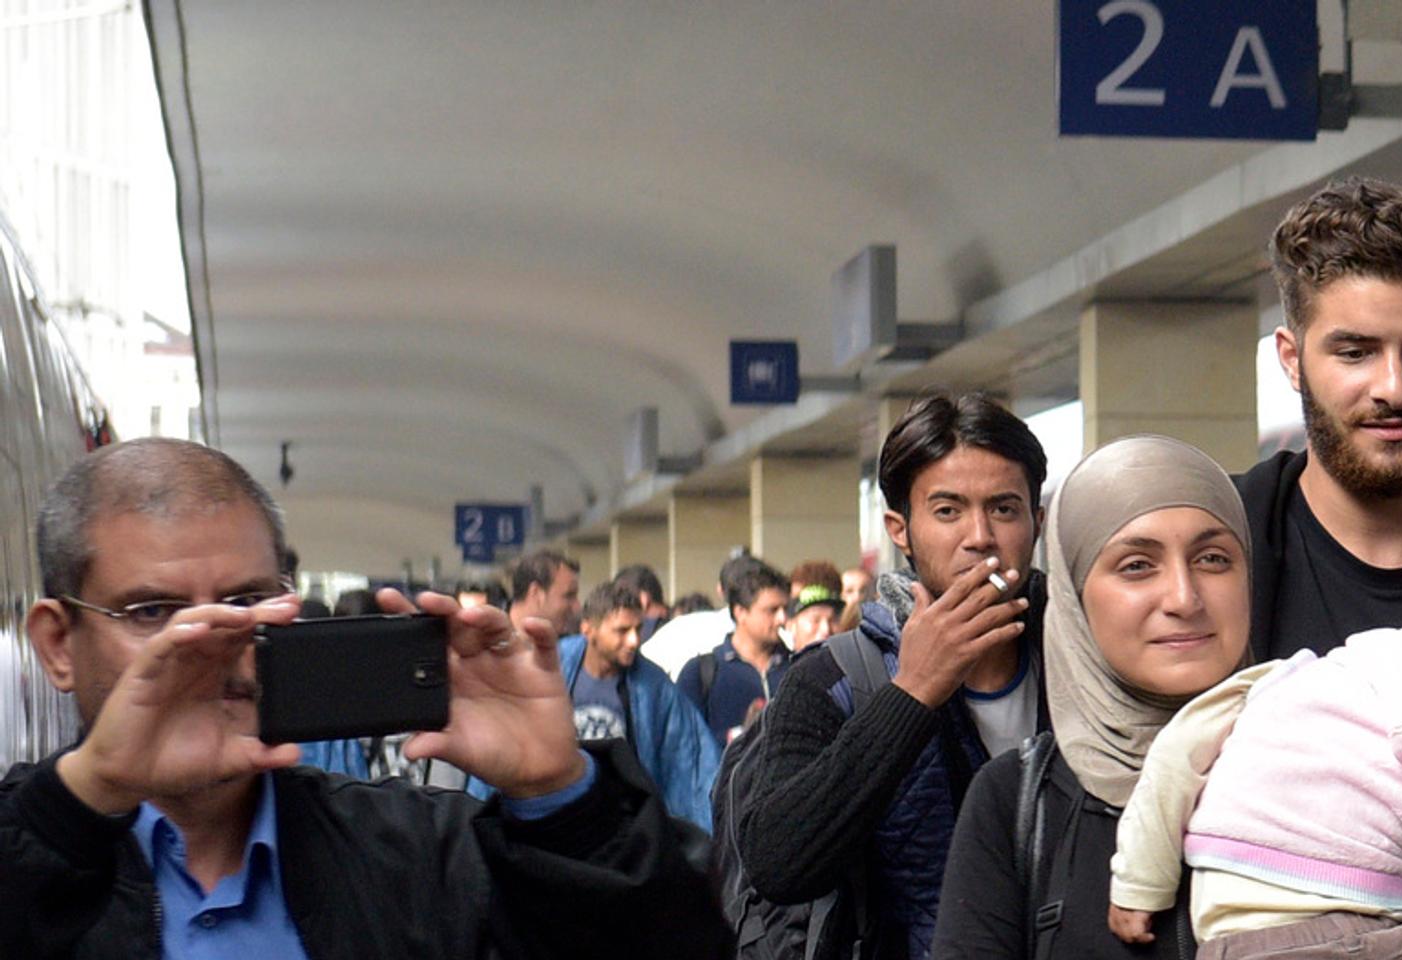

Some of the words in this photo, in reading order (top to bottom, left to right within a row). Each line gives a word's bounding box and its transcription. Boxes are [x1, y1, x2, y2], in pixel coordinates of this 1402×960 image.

[1095, 0, 1166, 106] 2
[1208, 25, 1287, 109] A
[463, 507, 484, 543] 2
